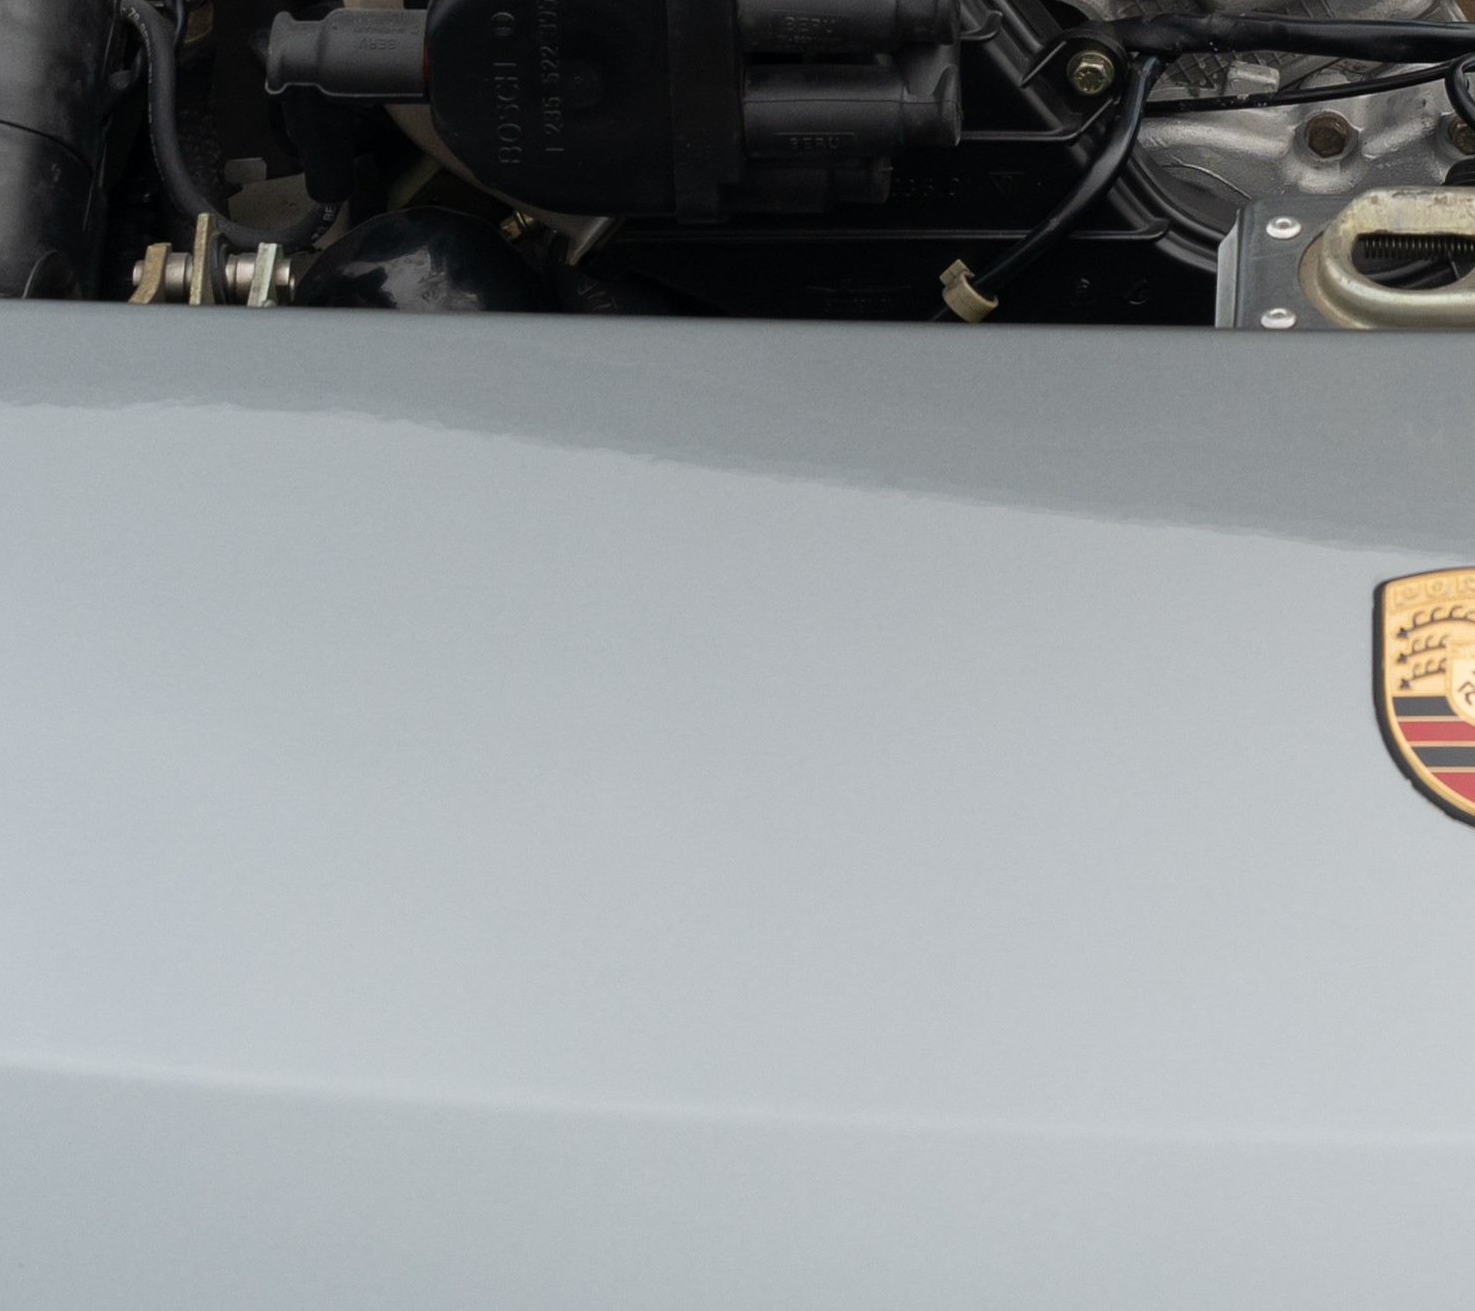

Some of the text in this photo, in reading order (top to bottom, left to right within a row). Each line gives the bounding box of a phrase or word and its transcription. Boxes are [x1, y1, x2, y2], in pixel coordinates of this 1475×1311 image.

[783, 15, 836, 35] BERU
[538, 45, 561, 84] 522
[493, 61, 523, 165] BOSCH
[789, 136, 841, 151] BERU
